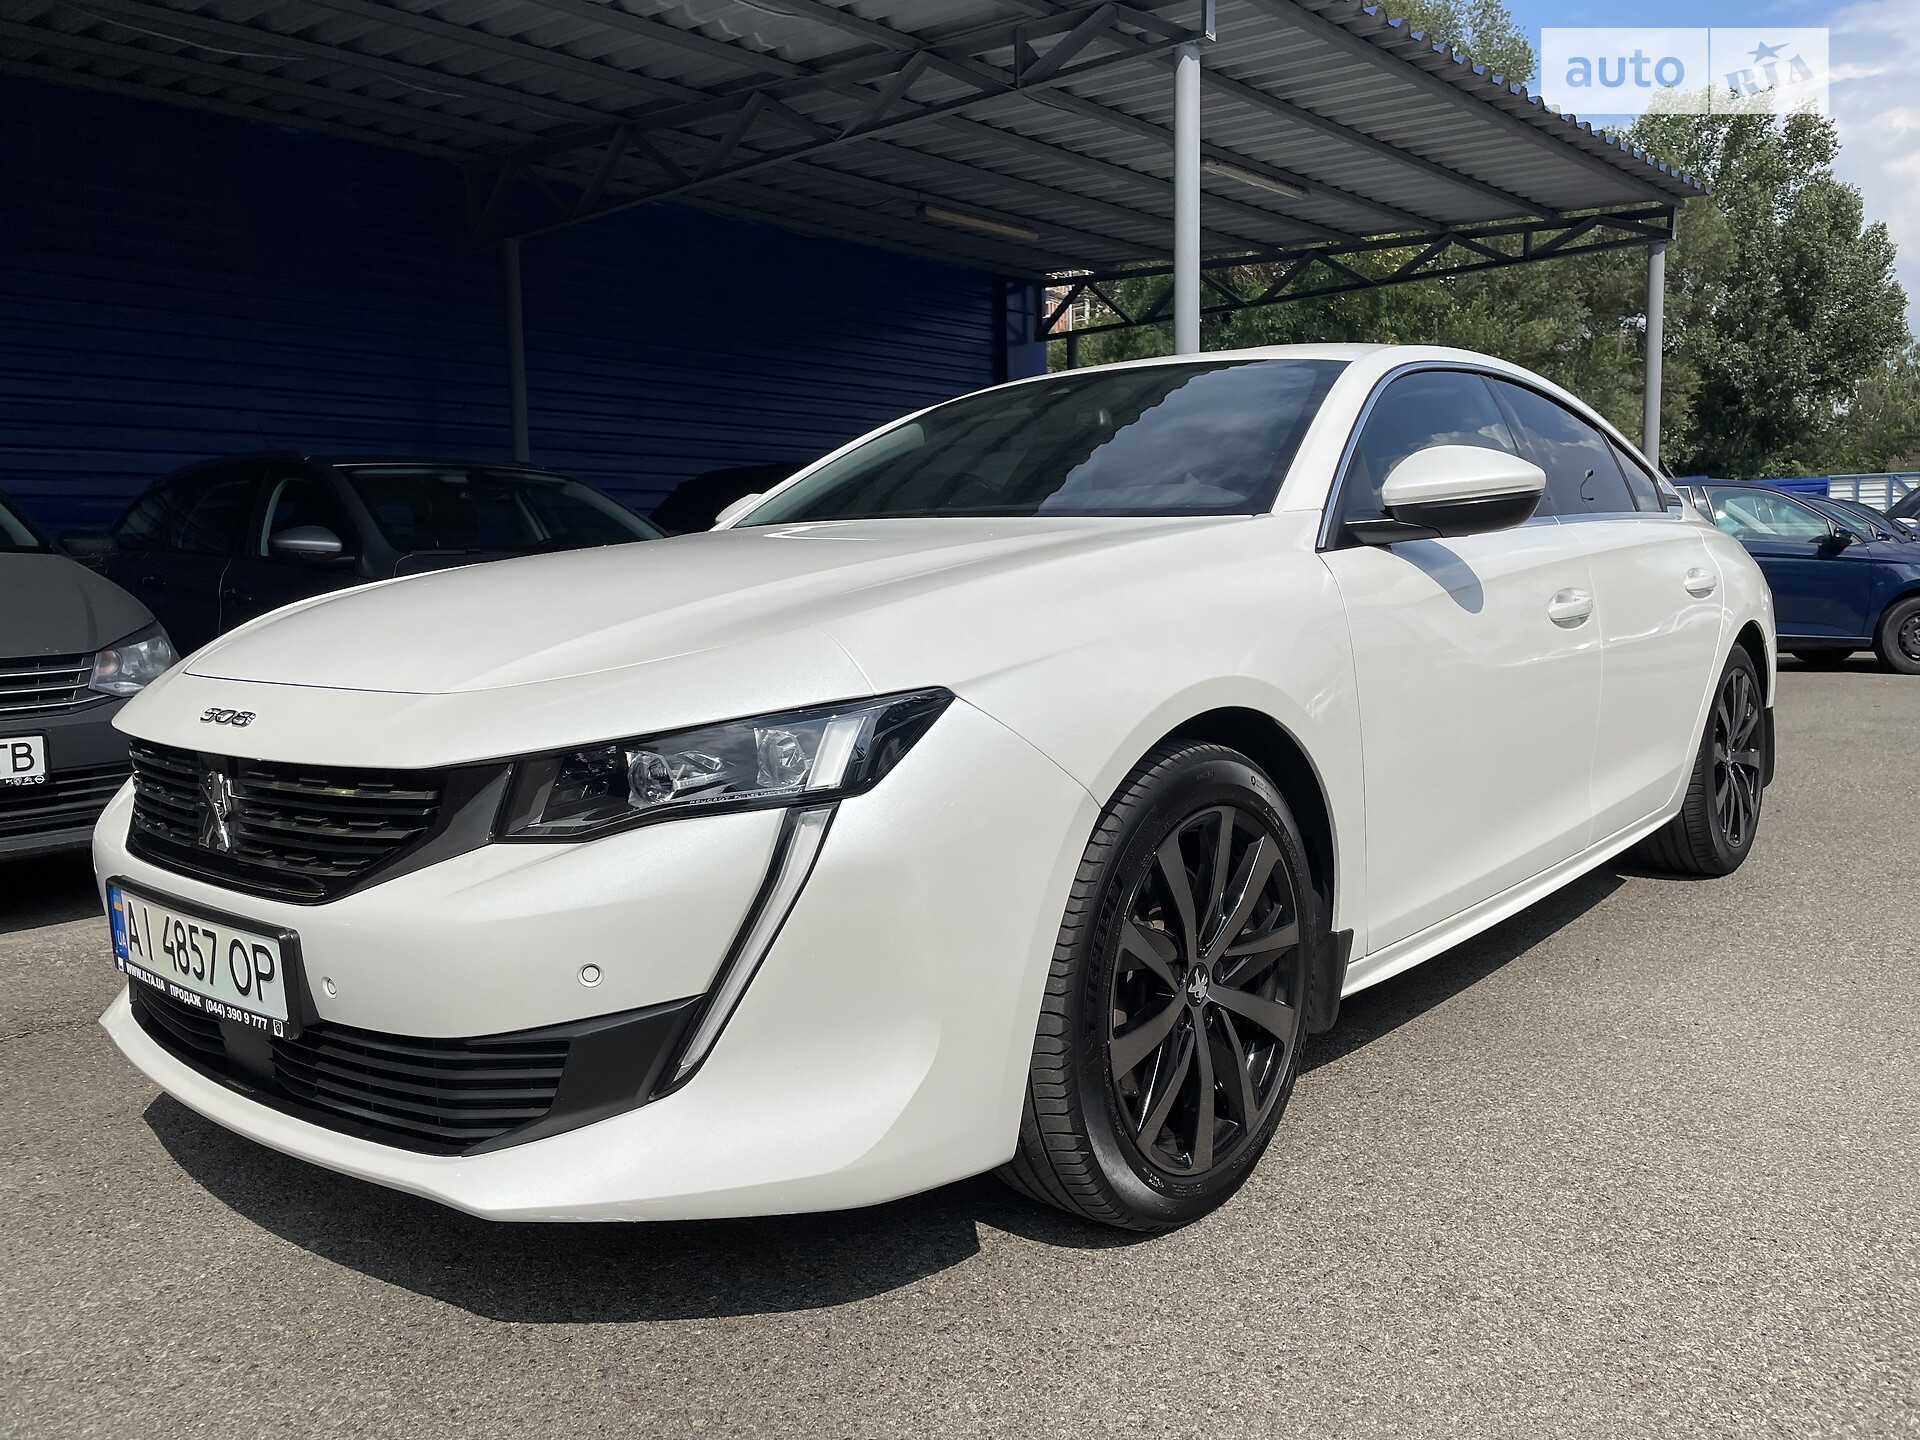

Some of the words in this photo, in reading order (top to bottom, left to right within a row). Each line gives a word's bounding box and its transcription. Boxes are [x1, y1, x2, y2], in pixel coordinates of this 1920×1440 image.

[116, 930, 128, 949] UA
[128, 900, 153, 961] AI
[162, 915, 217, 985] 4857
[229, 938, 275, 1001] OP
[169, 984, 202, 1007] ПРОДАЖ
[205, 998, 226, 1019] (044)
[226, 1006, 243, 1022] 390
[243, 1012, 250, 1025] 9
[251, 1014, 268, 1031] 777
